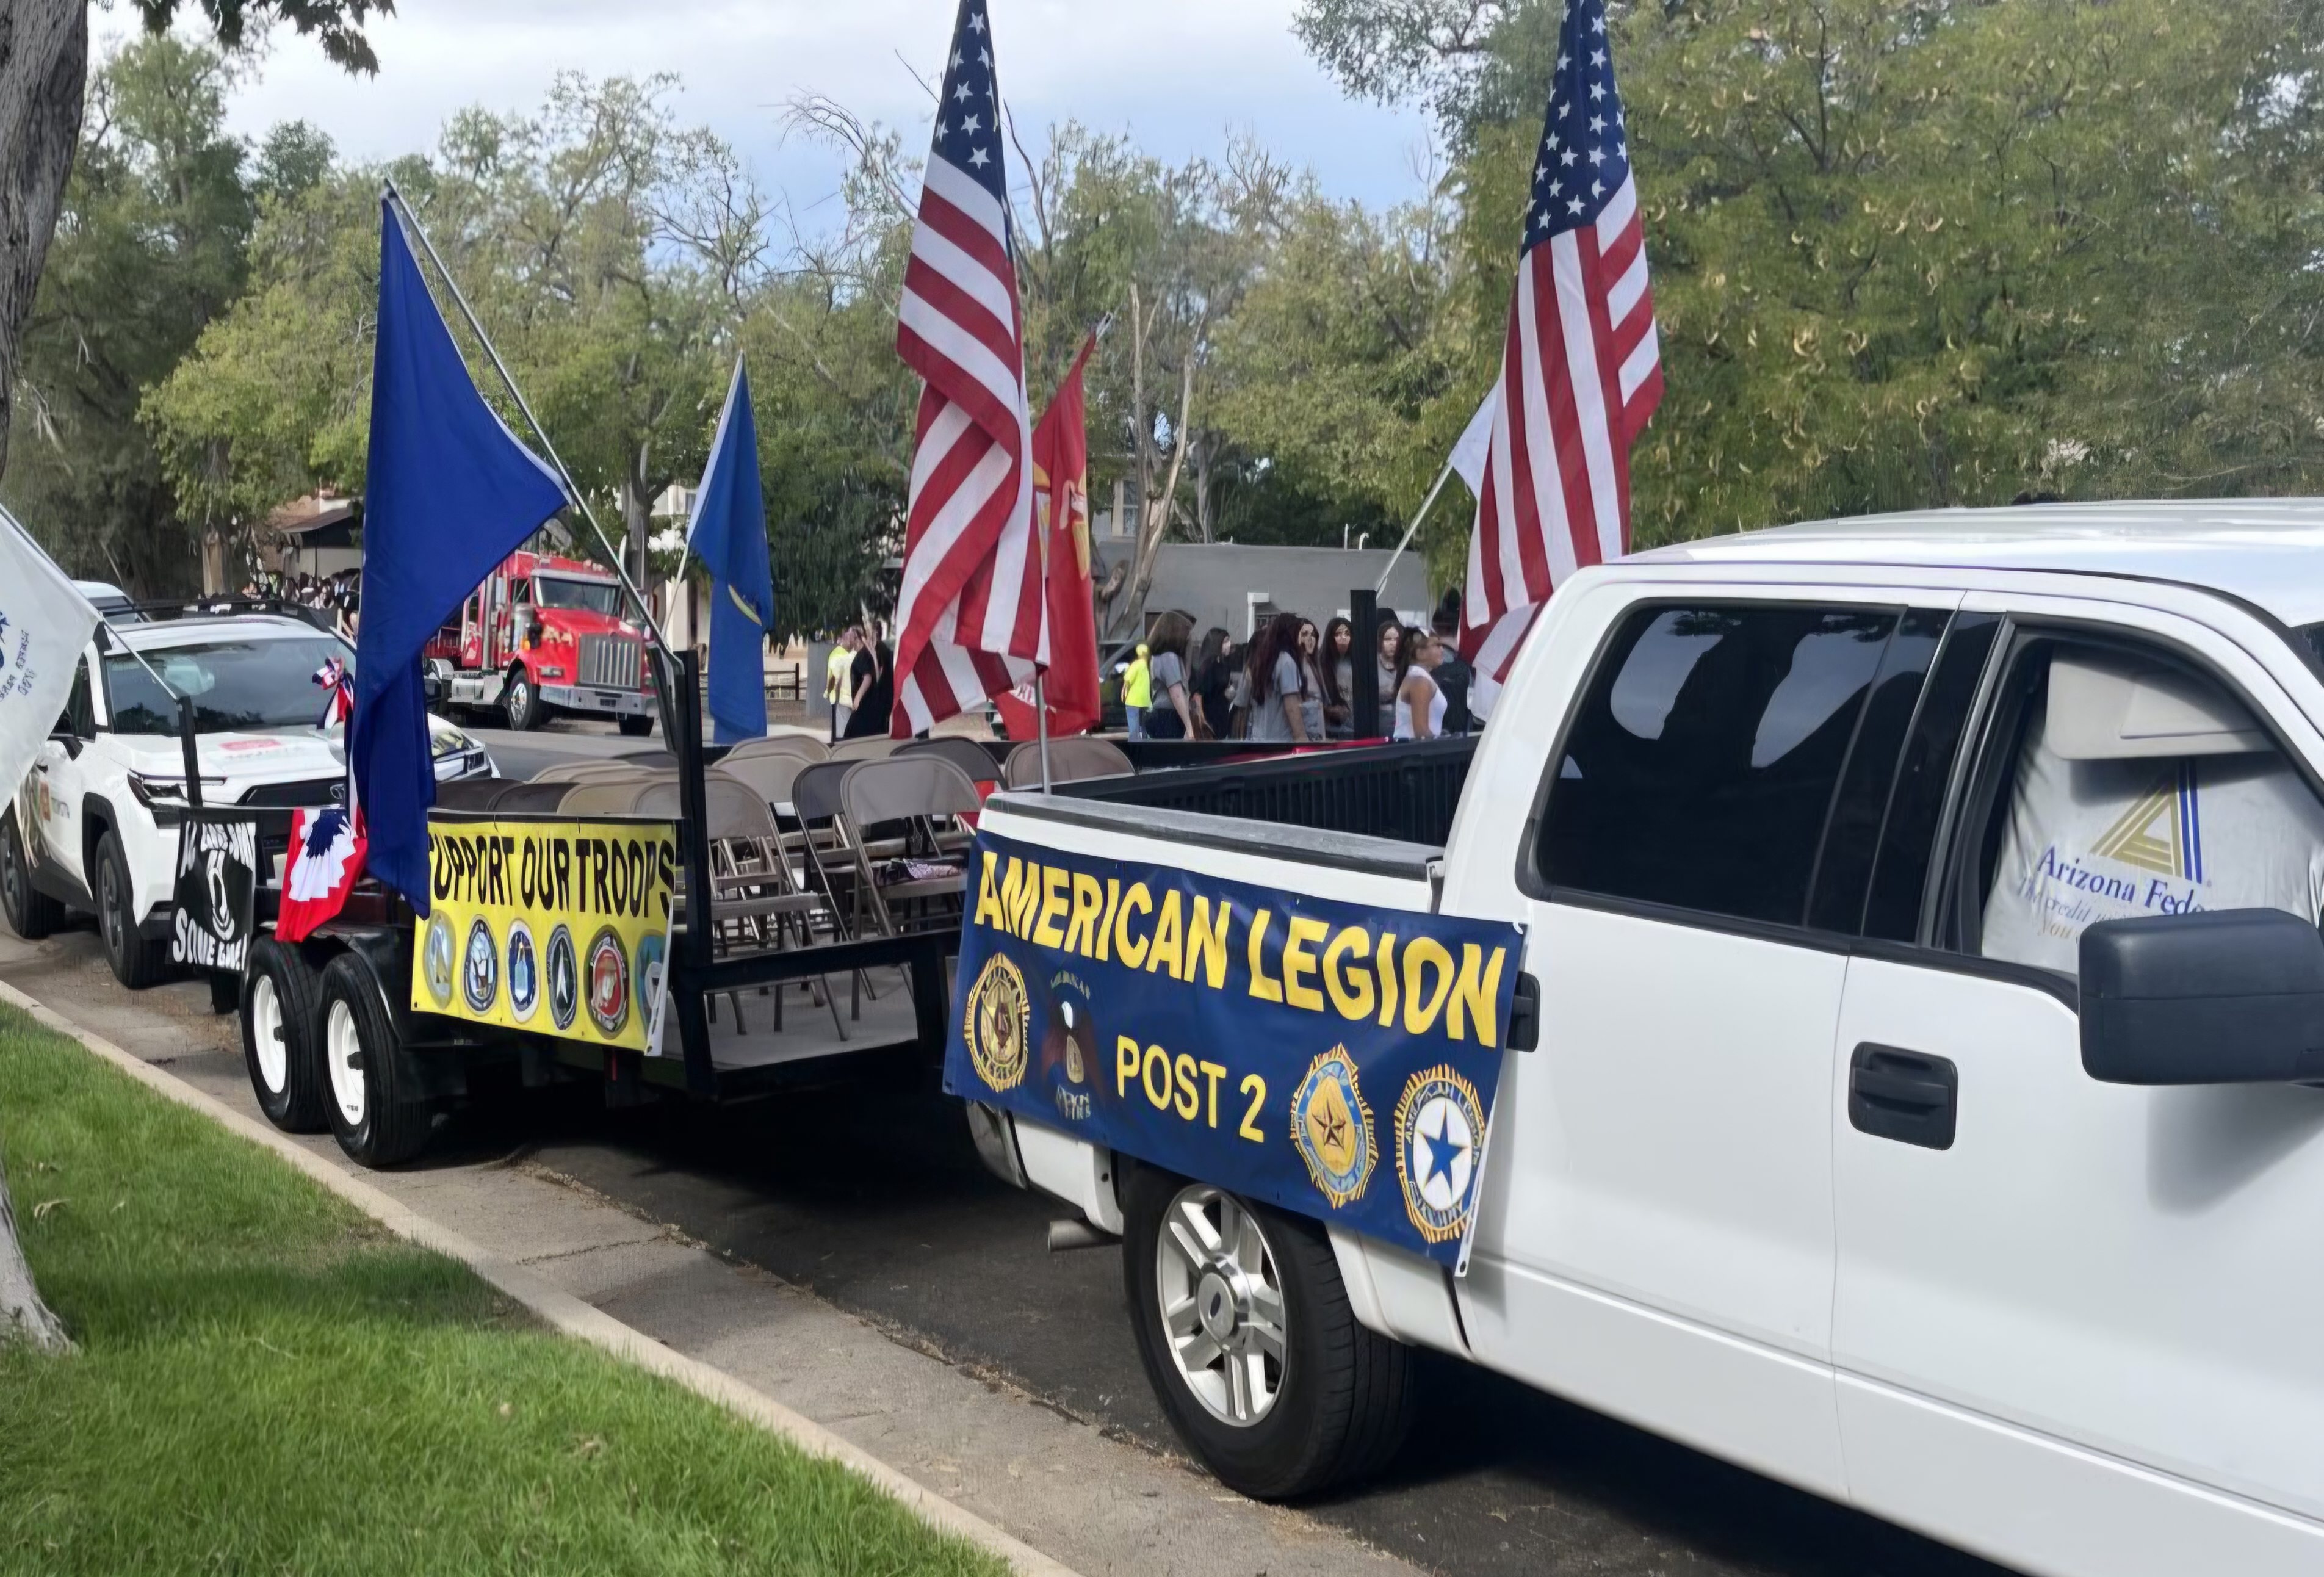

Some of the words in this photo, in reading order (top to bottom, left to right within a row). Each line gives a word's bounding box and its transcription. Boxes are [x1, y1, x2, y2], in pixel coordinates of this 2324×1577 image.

[428, 833, 514, 906] UPPORT
[522, 835, 570, 911] OUR
[575, 838, 675, 920] TROOPS
[2037, 846, 2135, 904] Arizona
[974, 851, 1232, 989] AMERICAN
[1248, 909, 1506, 1048] LEGION
[1117, 1034, 1227, 1128] POST
[1240, 1074, 1267, 1143] 2
